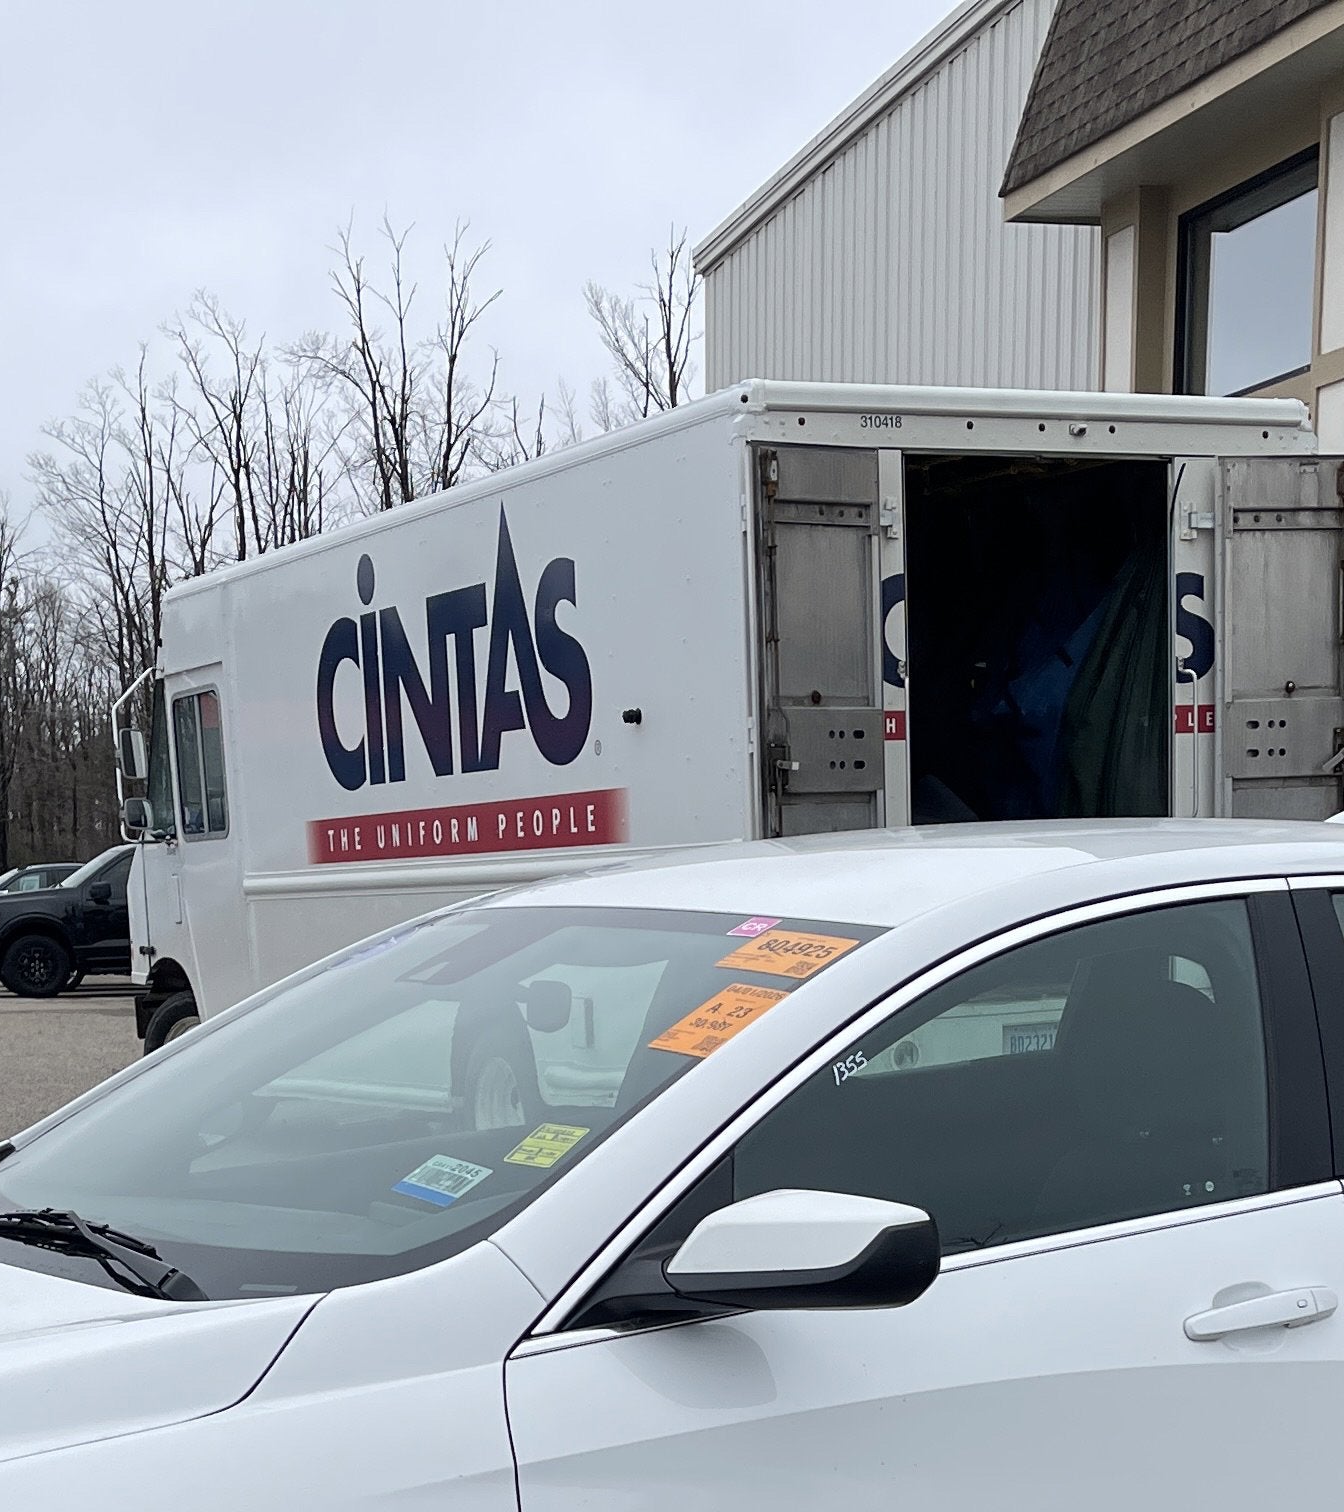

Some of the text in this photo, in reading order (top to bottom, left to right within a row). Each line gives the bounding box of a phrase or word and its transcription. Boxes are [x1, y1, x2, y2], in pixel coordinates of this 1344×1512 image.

[860, 415, 902, 428] 310418
[316, 500, 593, 791] CINTAS
[328, 804, 596, 852] THE UNIFORM PEOPLE
[757, 938, 838, 959] 804925
[706, 1002, 753, 1019] A 23
[832, 1050, 868, 1085] 1355
